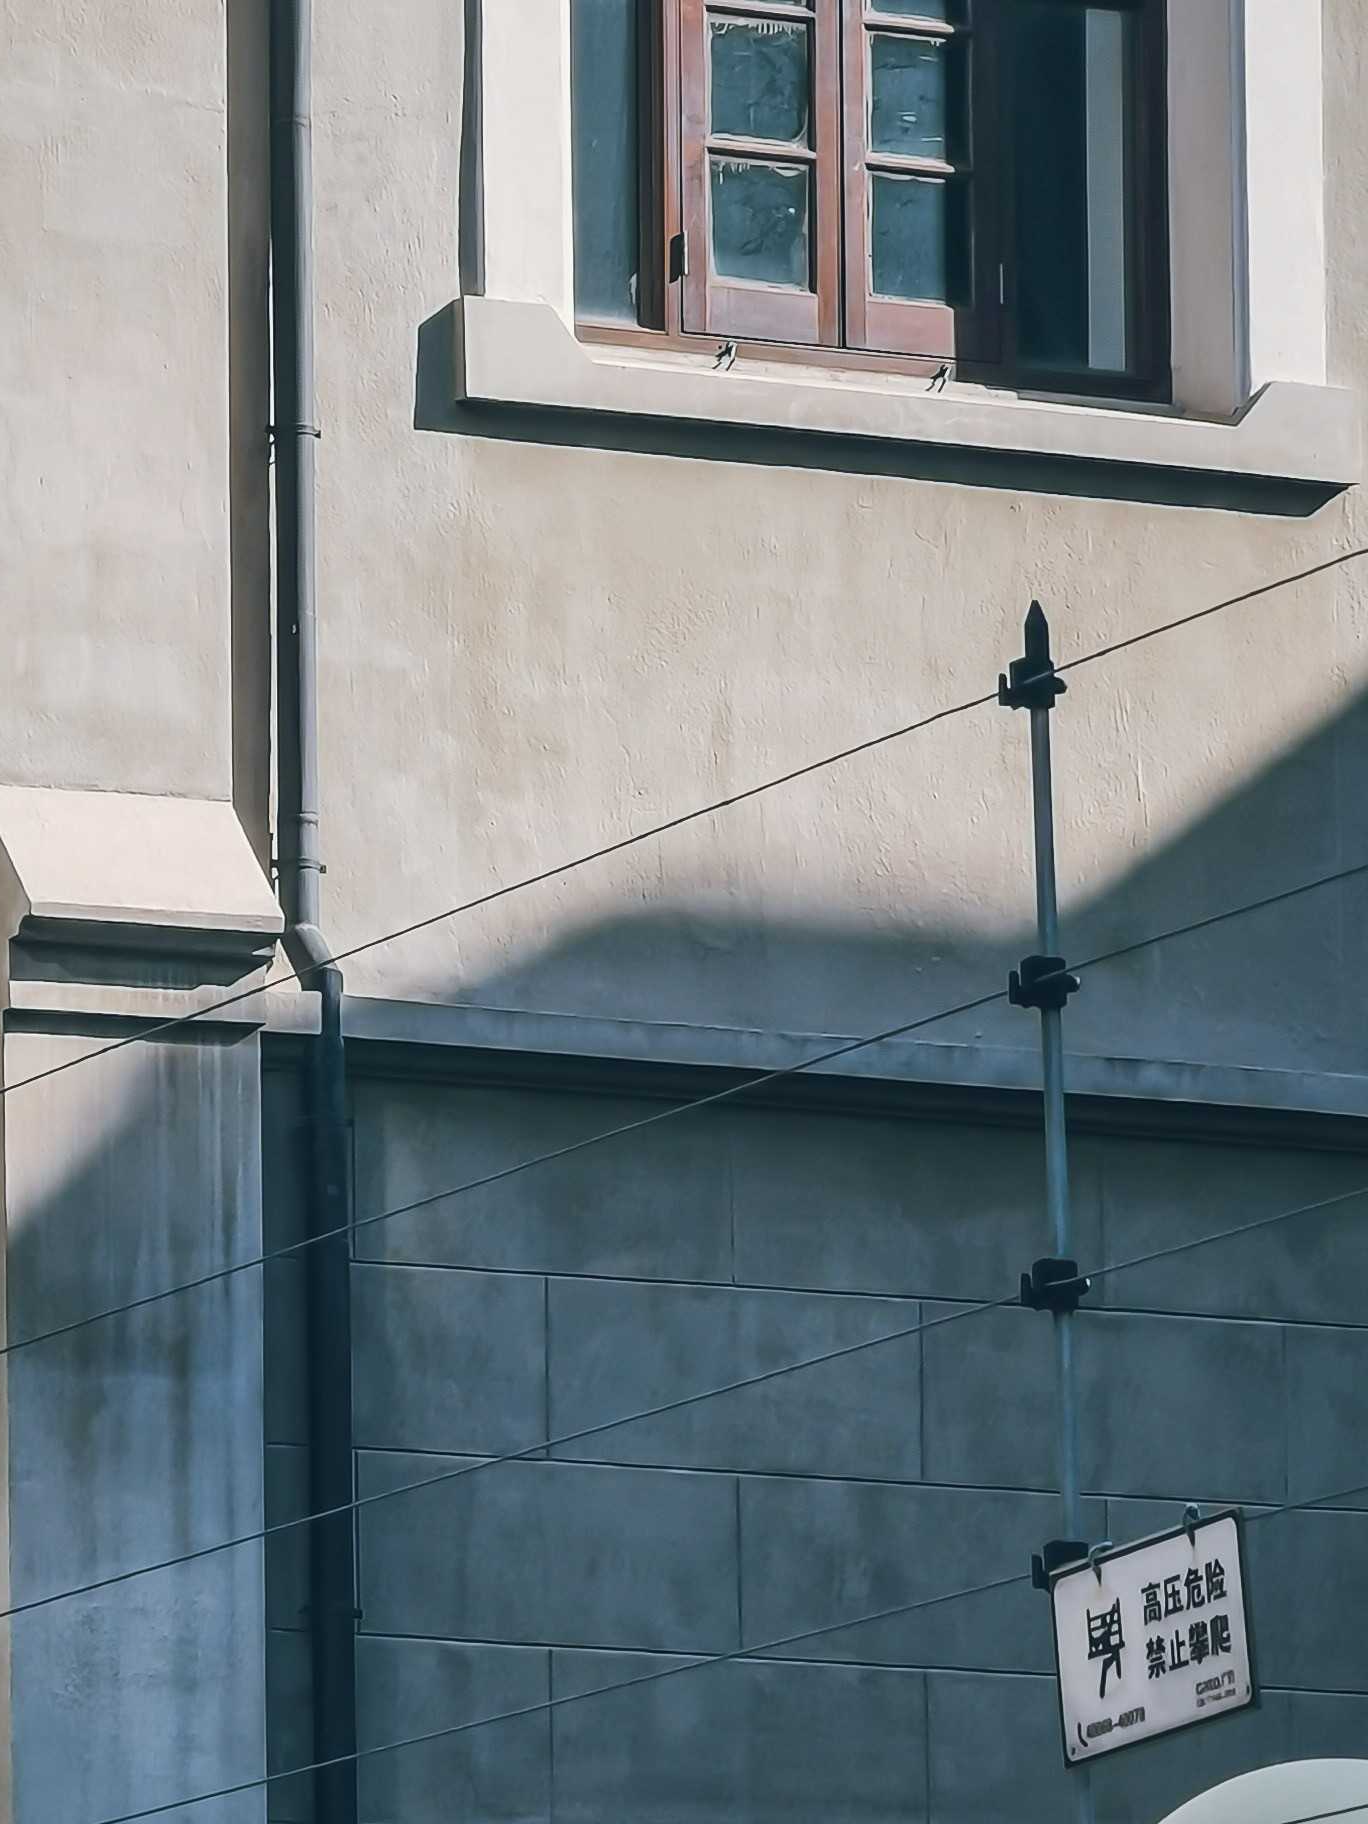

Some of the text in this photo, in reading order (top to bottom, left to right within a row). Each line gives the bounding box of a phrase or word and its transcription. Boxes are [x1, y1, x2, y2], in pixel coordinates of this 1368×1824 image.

[1141, 1559, 1227, 1626] 高压危险
[1146, 1614, 1231, 1679] 禁止攀爬
